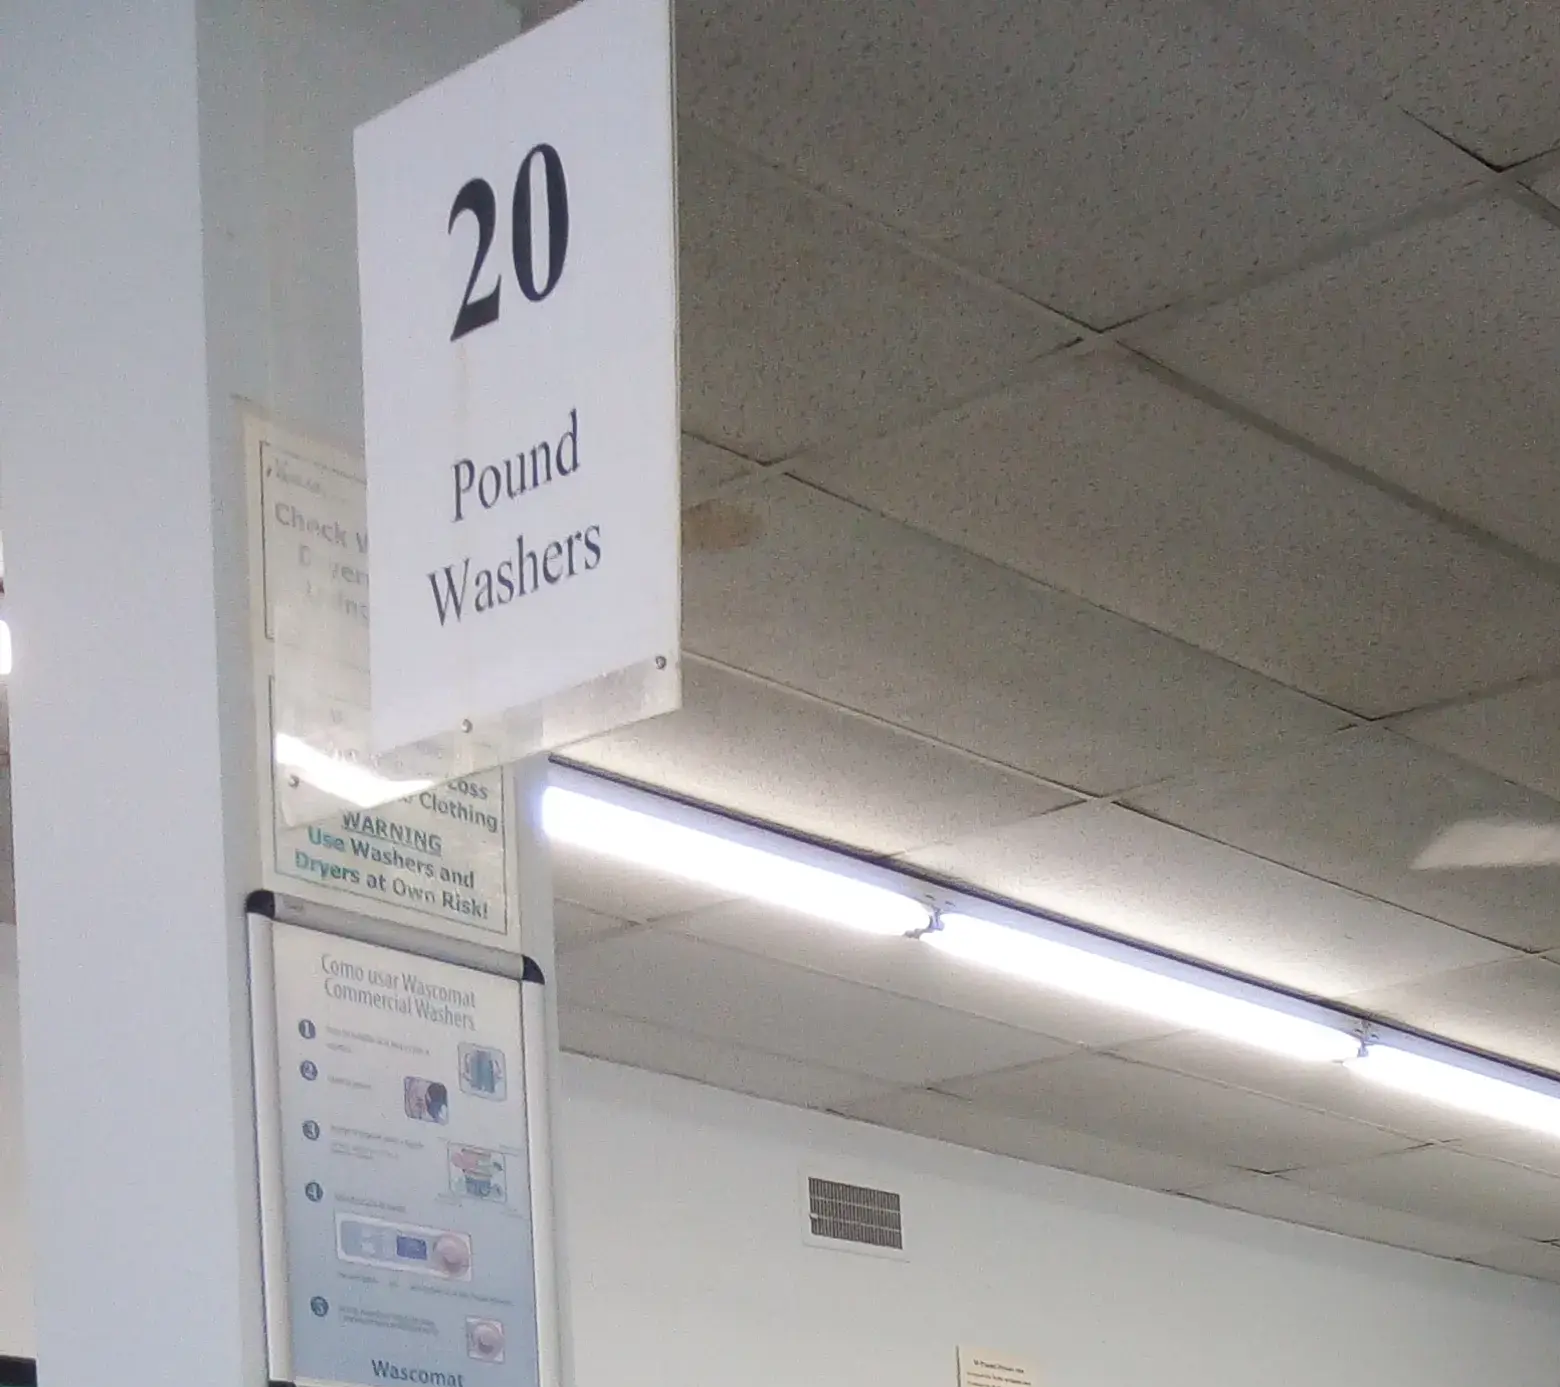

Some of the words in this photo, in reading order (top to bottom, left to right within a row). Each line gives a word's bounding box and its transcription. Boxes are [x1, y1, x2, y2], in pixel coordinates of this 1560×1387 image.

[447, 142, 570, 342] 20
[452, 408, 580, 522] Pound
[427, 523, 602, 627] Washers
[343, 812, 442, 851] WARNING
[419, 791, 498, 833] Clothing
[295, 848, 361, 883] Dryers
[366, 873, 386, 892] at
[393, 878, 435, 904] Own
[442, 890, 488, 920] Risk!
[308, 825, 345, 852] Use
[350, 838, 434, 877] Washers
[440, 867, 475, 888] and
[321, 953, 364, 982] Como
[368, 968, 399, 990] usar
[401, 972, 476, 1009] Wascomat
[324, 977, 411, 1015] Commercial
[414, 998, 476, 1032] Washers
